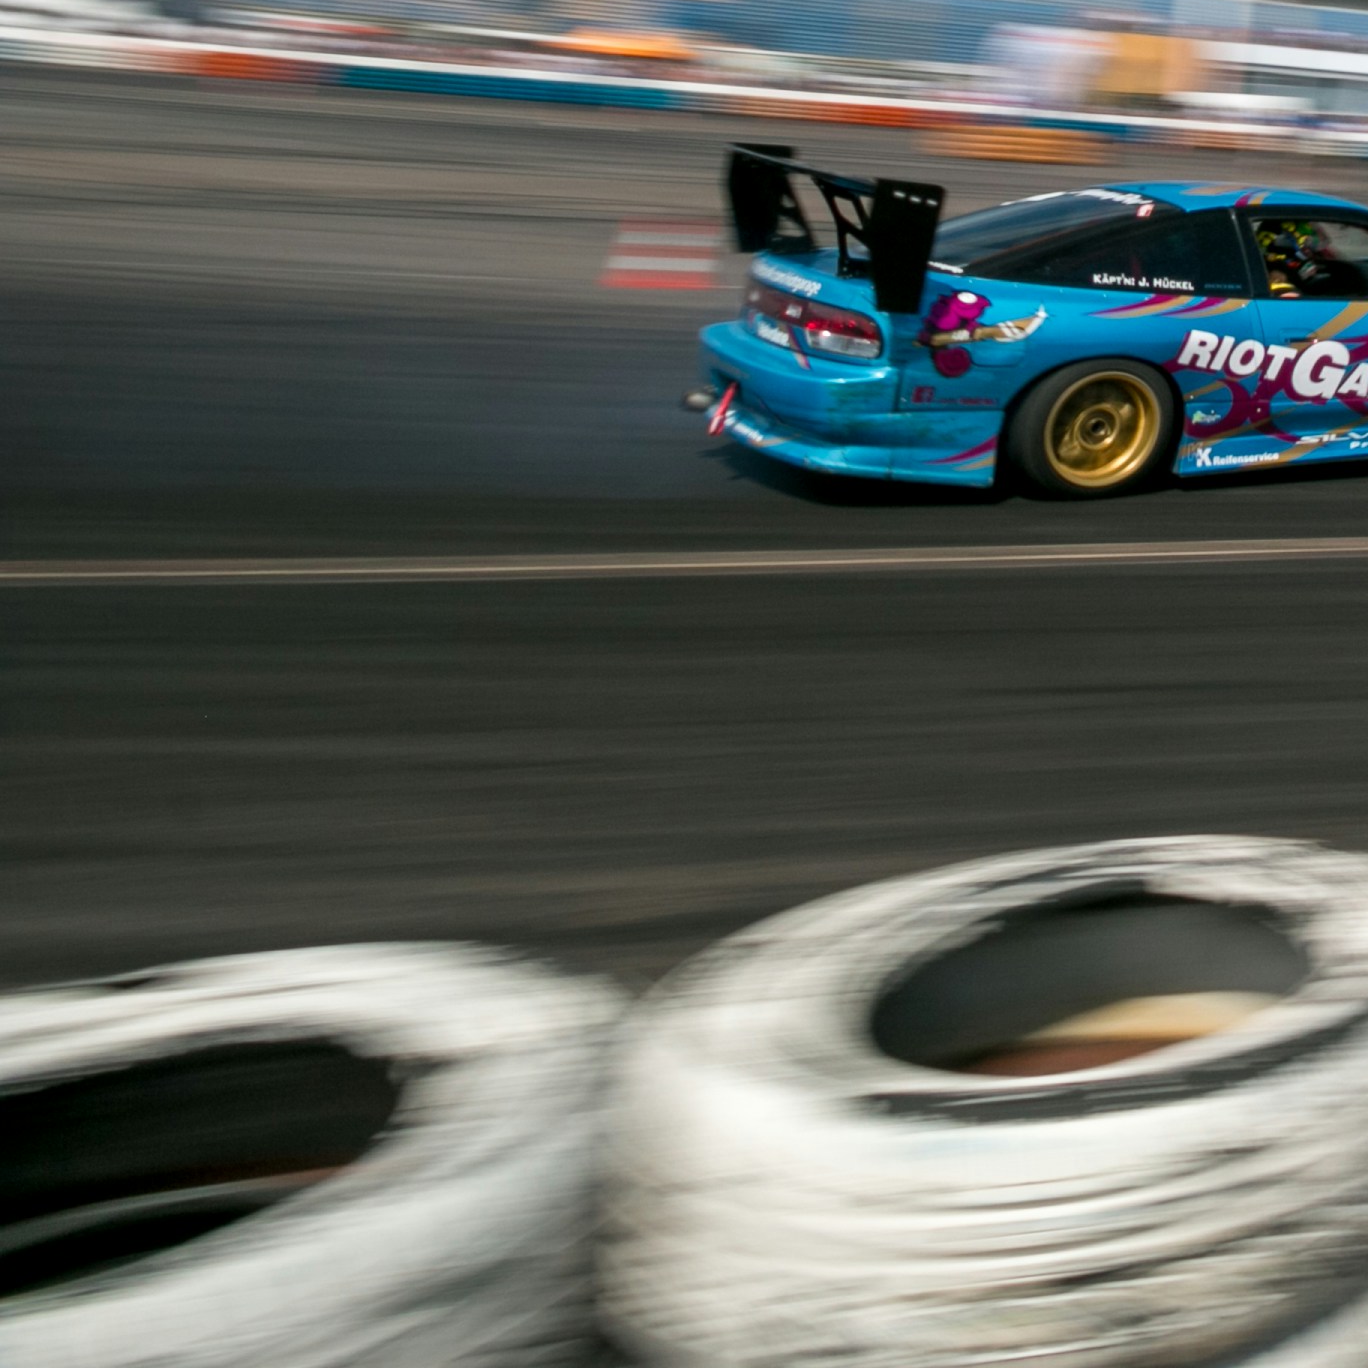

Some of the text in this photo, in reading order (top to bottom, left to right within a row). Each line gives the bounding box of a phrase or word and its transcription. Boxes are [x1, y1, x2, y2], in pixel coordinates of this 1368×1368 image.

[1138, 277, 1150, 287] J.
[1153, 277, 1195, 291] HÜCKEL
[1213, 451, 1280, 466] Reifenservice
